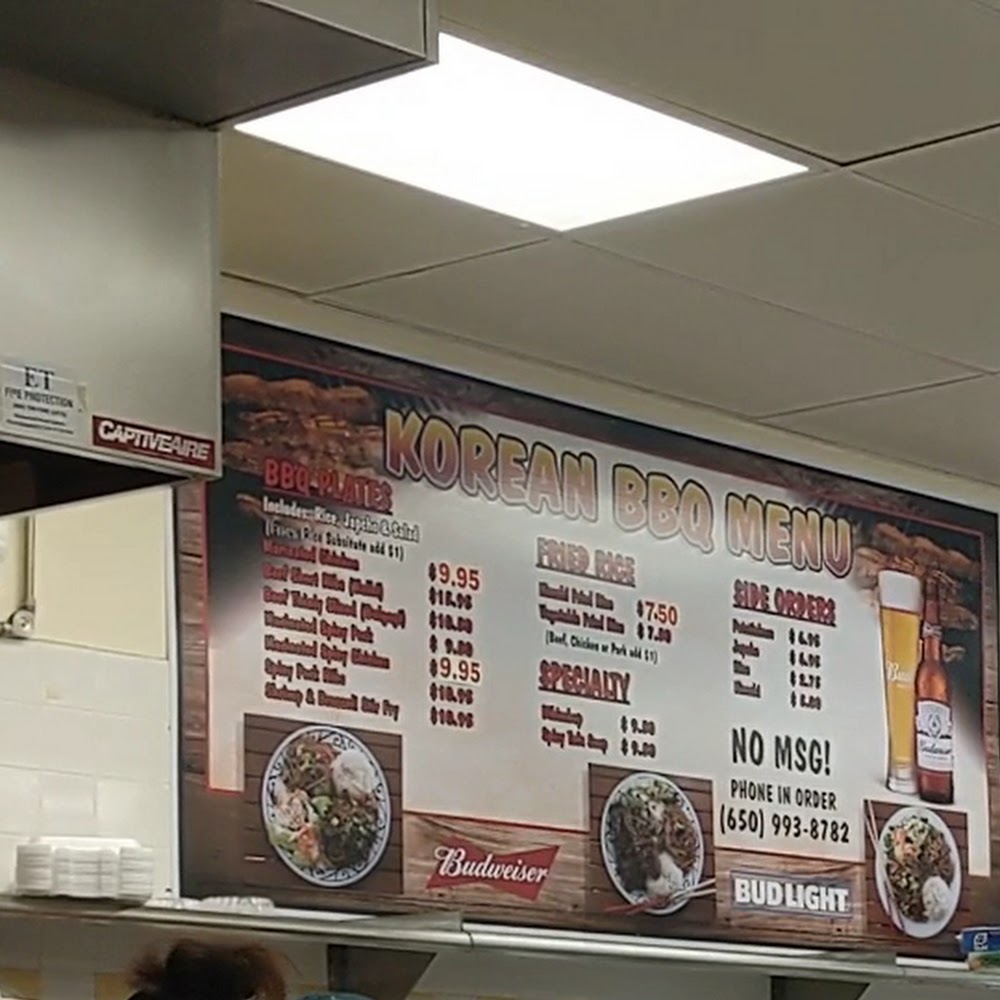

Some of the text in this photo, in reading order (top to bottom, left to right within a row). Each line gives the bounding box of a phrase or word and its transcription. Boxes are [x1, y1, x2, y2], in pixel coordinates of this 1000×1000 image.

[25, 366, 54, 390] ET
[264, 457, 393, 513] BBQ PLATES
[385, 408, 855, 578] KOREAN BBQ MENU
[536, 537, 636, 585] FRIED RICE
[733, 578, 836, 625] SIDE ORDERS
[538, 658, 630, 702] SPECIALTY
[731, 726, 831, 777] NO MSG!
[730, 778, 838, 812] PHONE IN ORDER
[720, 802, 850, 845] (650) 993-8782
[434, 846, 549, 884] Budweiser
[735, 878, 849, 913] BUD LIGHT
